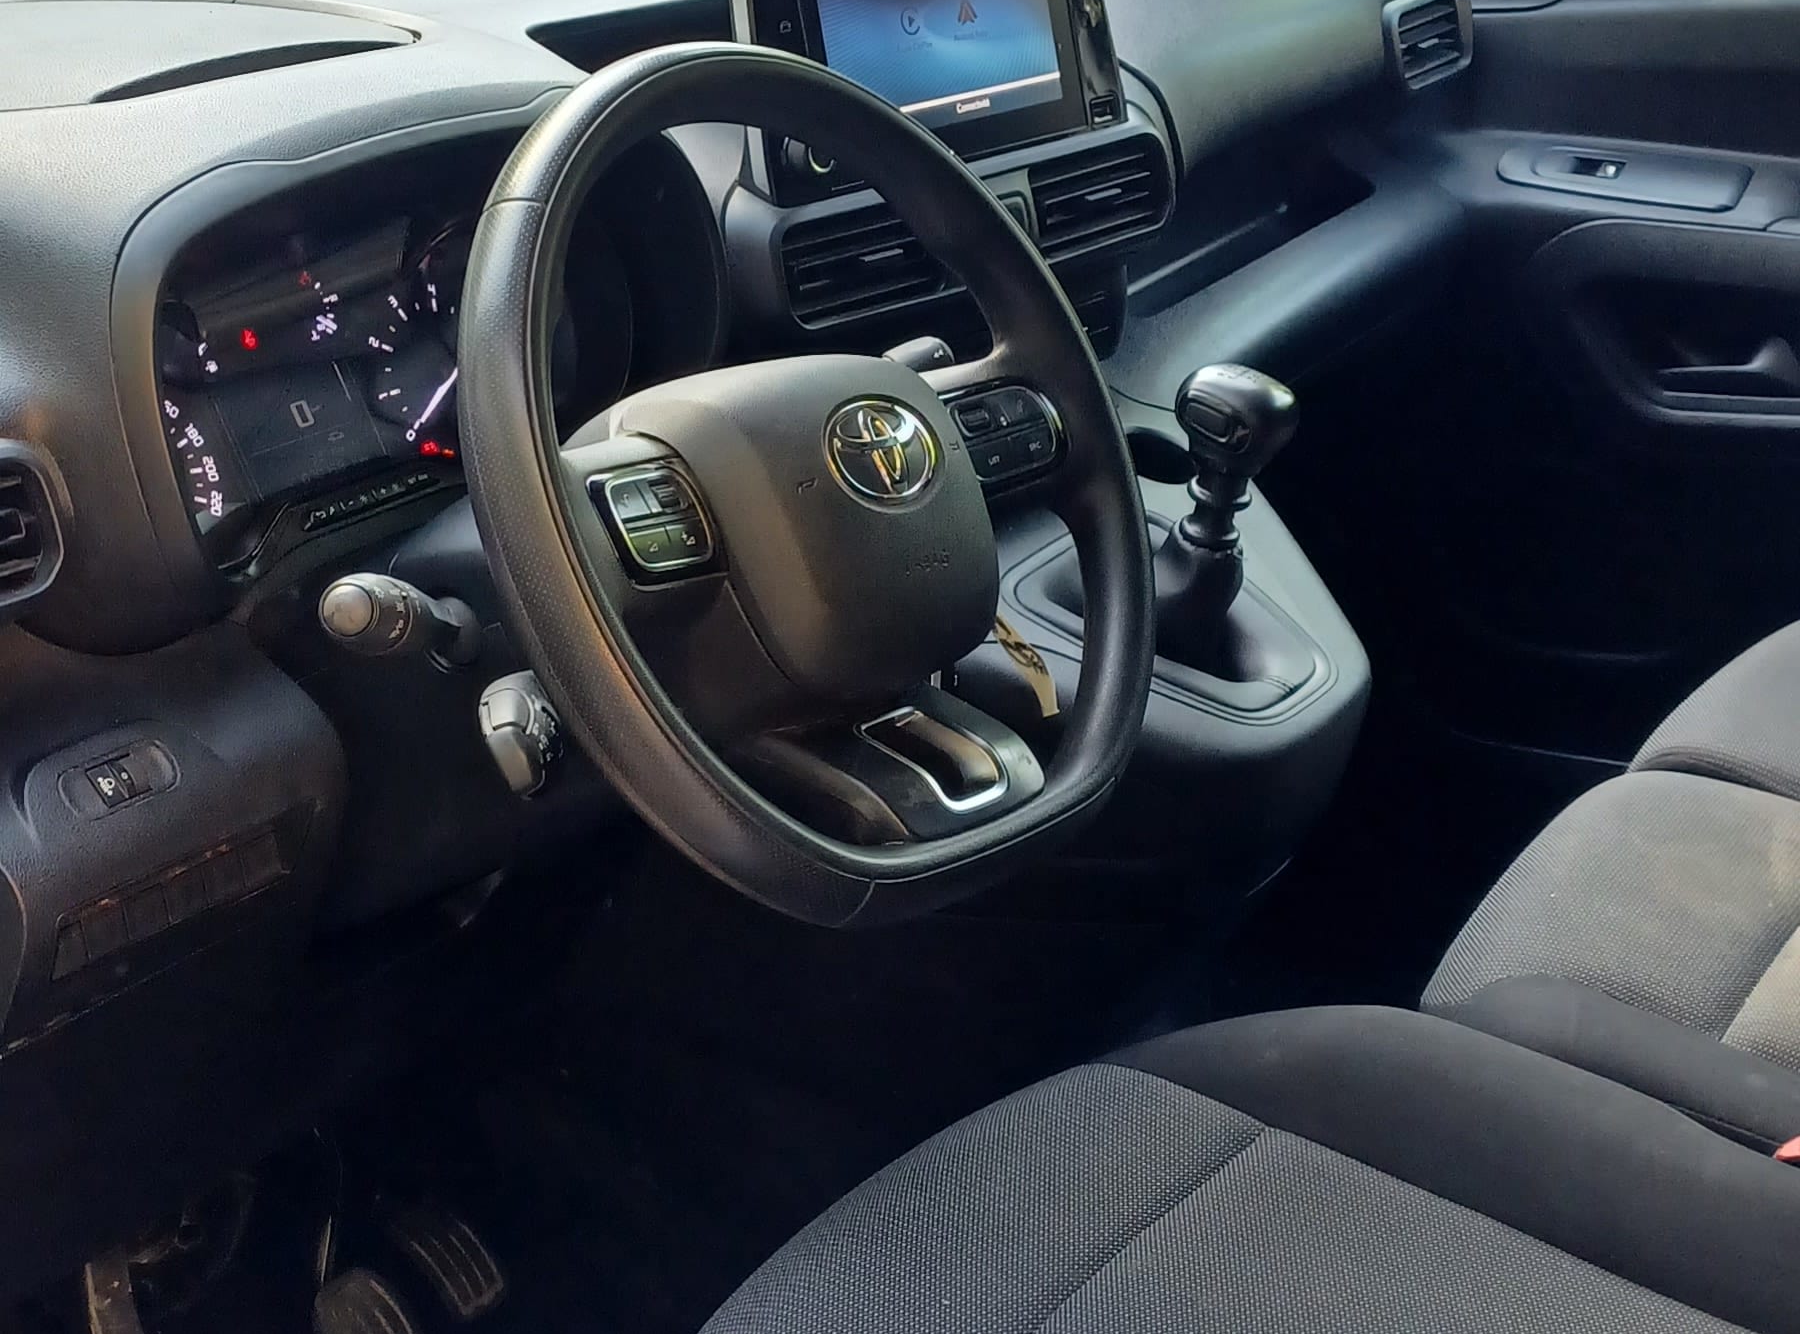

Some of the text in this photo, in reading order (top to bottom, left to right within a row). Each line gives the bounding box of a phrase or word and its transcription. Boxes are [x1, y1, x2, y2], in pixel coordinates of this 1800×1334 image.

[387, 294, 399, 309] 3
[368, 335, 380, 348] 2
[290, 399, 315, 428] 0
[184, 423, 204, 447] 180
[405, 428, 417, 442] 0
[202, 455, 219, 482] 200
[210, 490, 223, 517] 220
